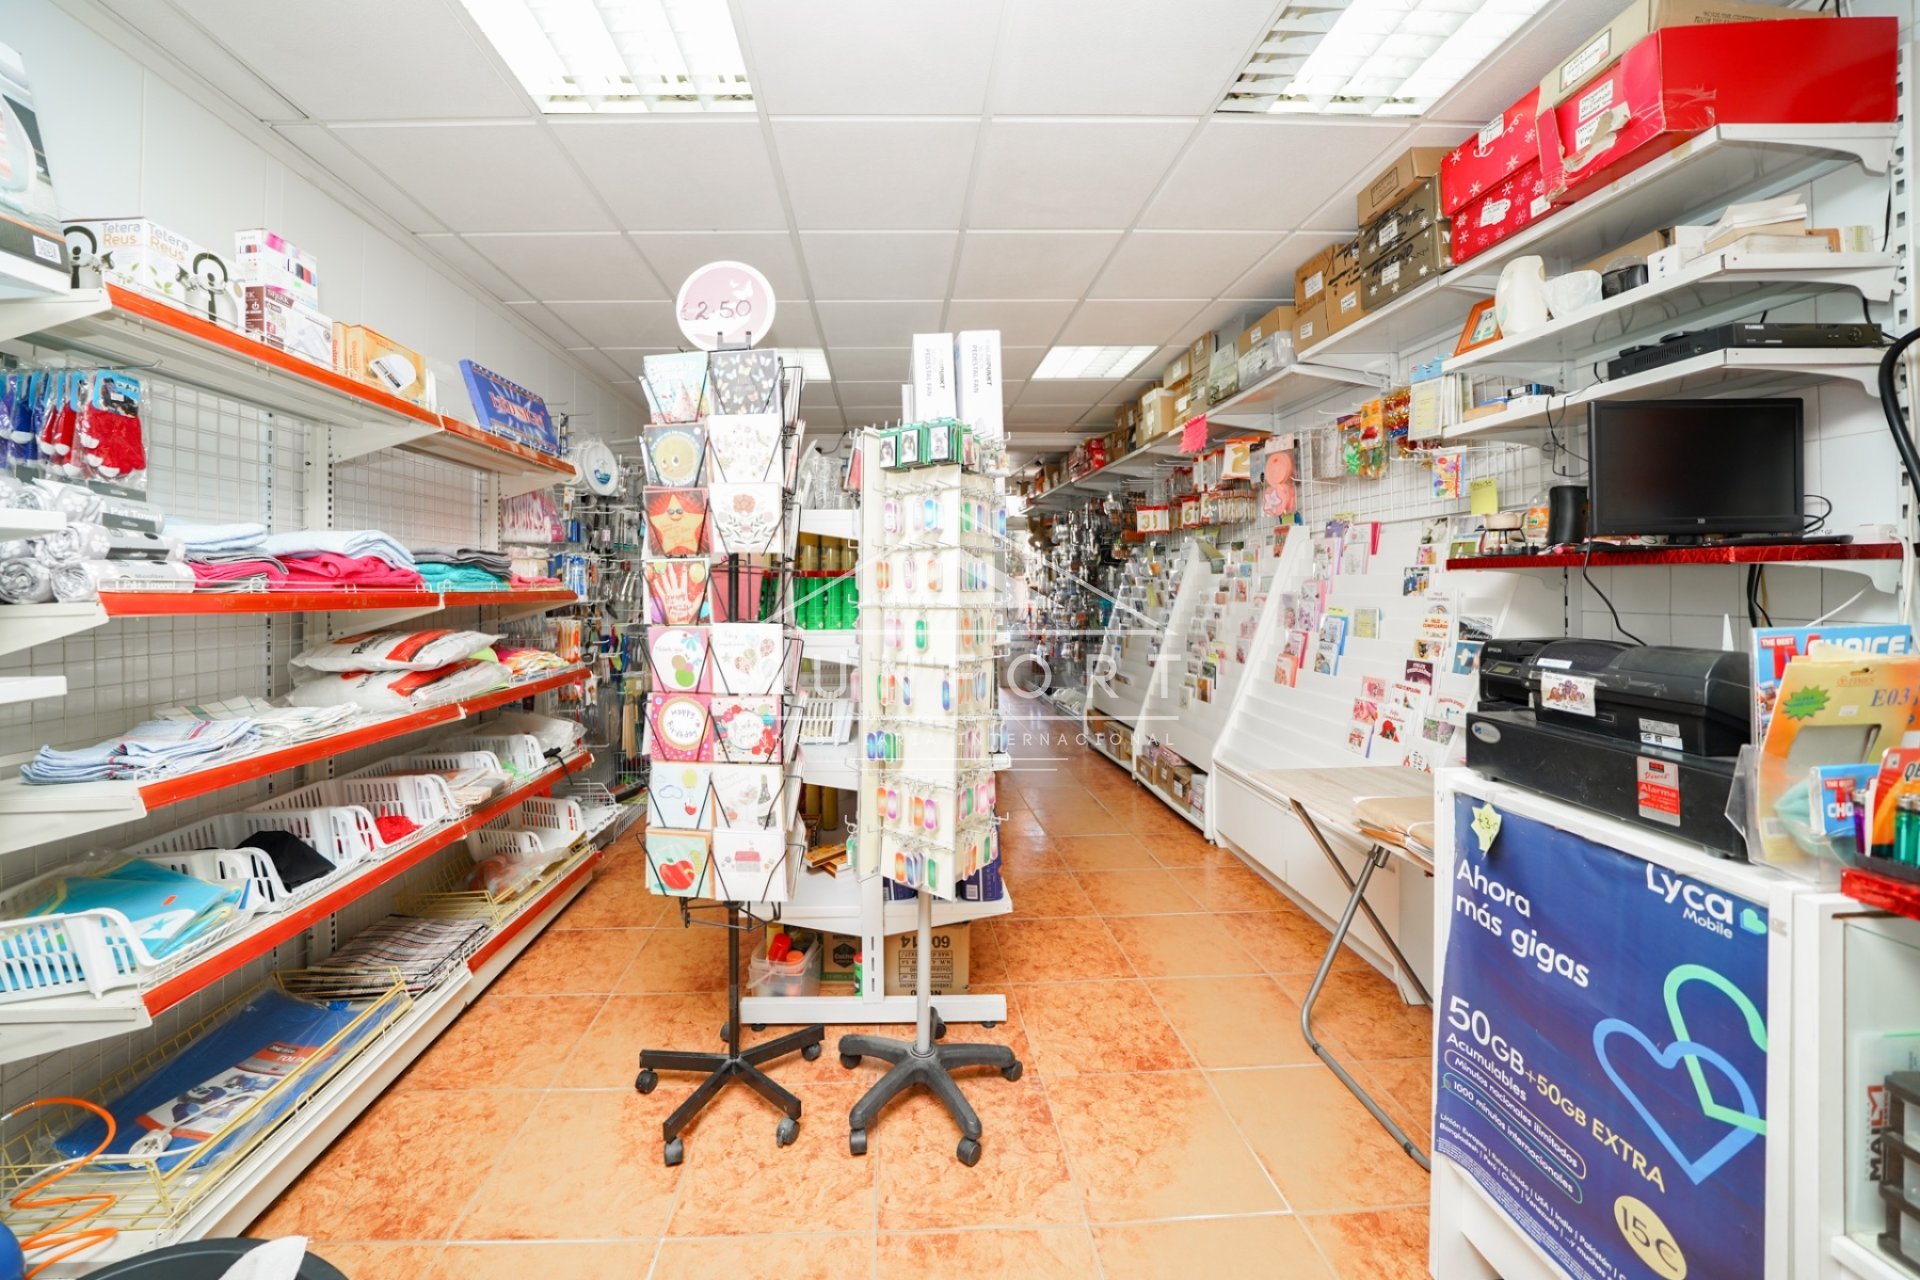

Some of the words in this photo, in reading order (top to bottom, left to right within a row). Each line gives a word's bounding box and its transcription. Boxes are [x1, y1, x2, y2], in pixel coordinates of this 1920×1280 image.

[102, 222, 141, 233] Tetera
[103, 233, 137, 246] Reus
[149, 224, 189, 251] Tetera
[150, 235, 186, 262] Reus
[1760, 638, 1775, 646] THE
[1776, 637, 1795, 646] BEST
[1640, 783, 1678, 799] Alarma
[1456, 858, 1531, 918] Ahora
[1646, 862, 1734, 925] Lyca
[1456, 894, 1503, 937] más
[1511, 928, 1590, 989] gigas
[1683, 907, 1733, 939] Mobile
[1446, 1032, 1527, 1102] Acumulables
[1453, 1081, 1475, 1101] 1000
[1475, 1099, 1506, 1131] minutos
[1506, 1123, 1574, 1194] internacionales
[1454, 1057, 1489, 1088] Minutos
[1489, 1084, 1533, 1128] nacionales
[1533, 1121, 1578, 1168] ilimitados
[1592, 1117, 1666, 1194] EXTRA
[1501, 1171, 1520, 1193] China
[1525, 1193, 1560, 1232] Venezuela
[1576, 1246, 1606, 1278] muchos
[1534, 1191, 1550, 1211] USA
[1579, 1235, 1613, 1272] Pakistán
[1621, 1204, 1680, 1273] 15€
